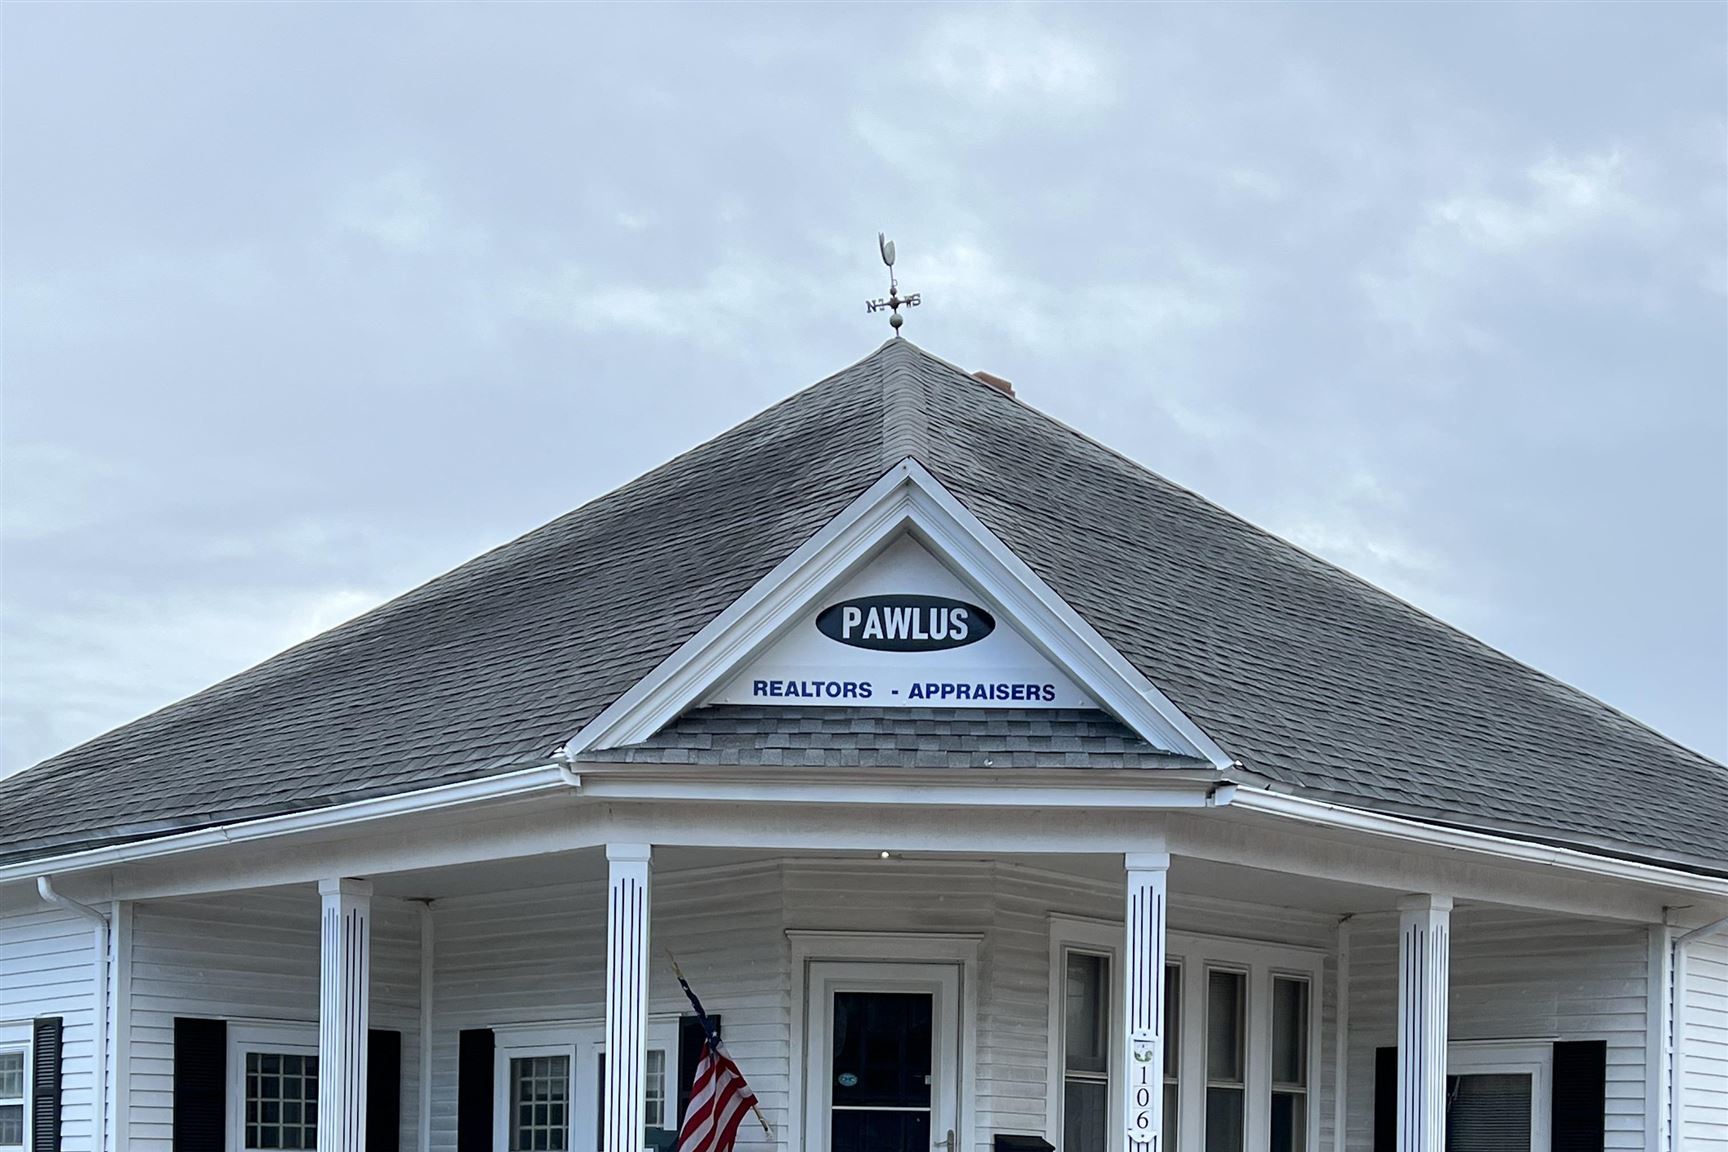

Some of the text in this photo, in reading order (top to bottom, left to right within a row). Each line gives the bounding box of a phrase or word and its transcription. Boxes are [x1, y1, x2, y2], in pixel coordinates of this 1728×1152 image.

[865, 299, 877, 313] N
[842, 606, 969, 640] PAWLUS
[753, 680, 872, 698] REALTORS
[908, 683, 1055, 701] APPRAISERS
[1136, 1066, 1150, 1129] 106
